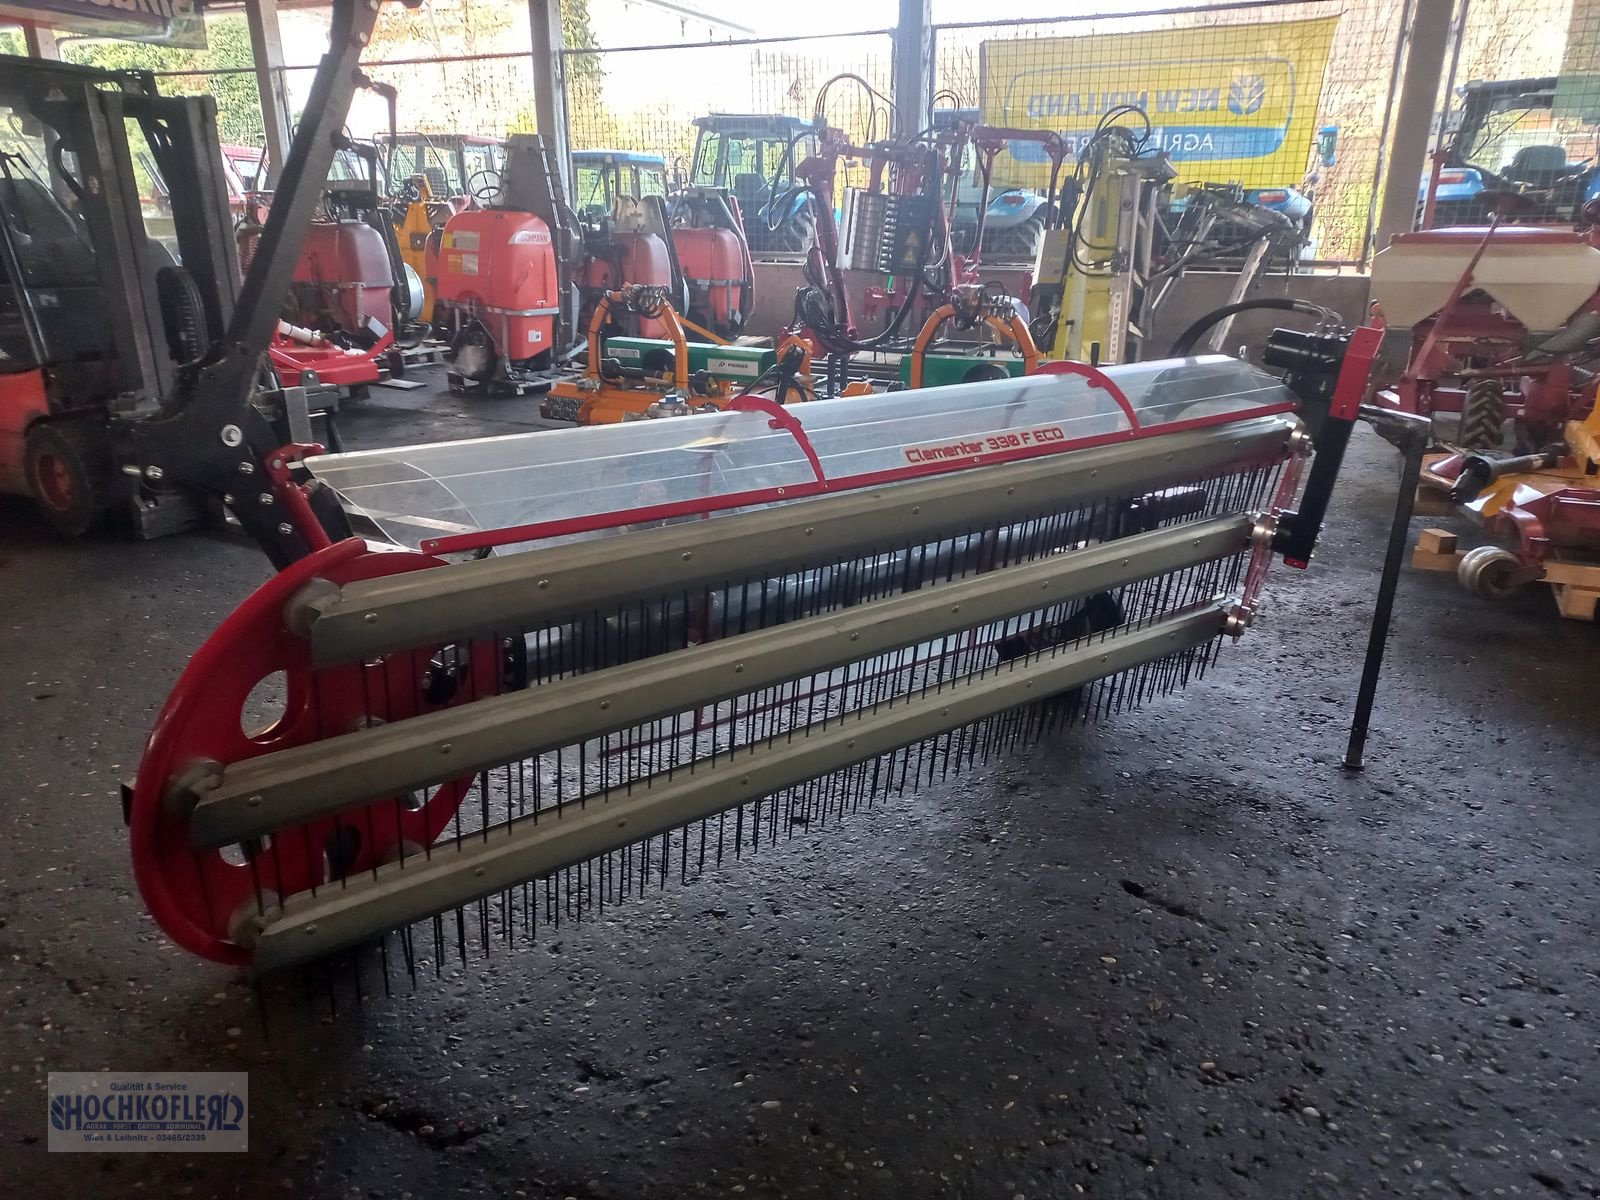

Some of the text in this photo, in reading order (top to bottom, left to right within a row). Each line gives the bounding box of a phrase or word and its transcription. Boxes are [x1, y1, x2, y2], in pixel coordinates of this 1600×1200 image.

[905, 442, 984, 462] Clementer
[1020, 432, 1030, 444] F
[1033, 427, 1064, 442] ECO
